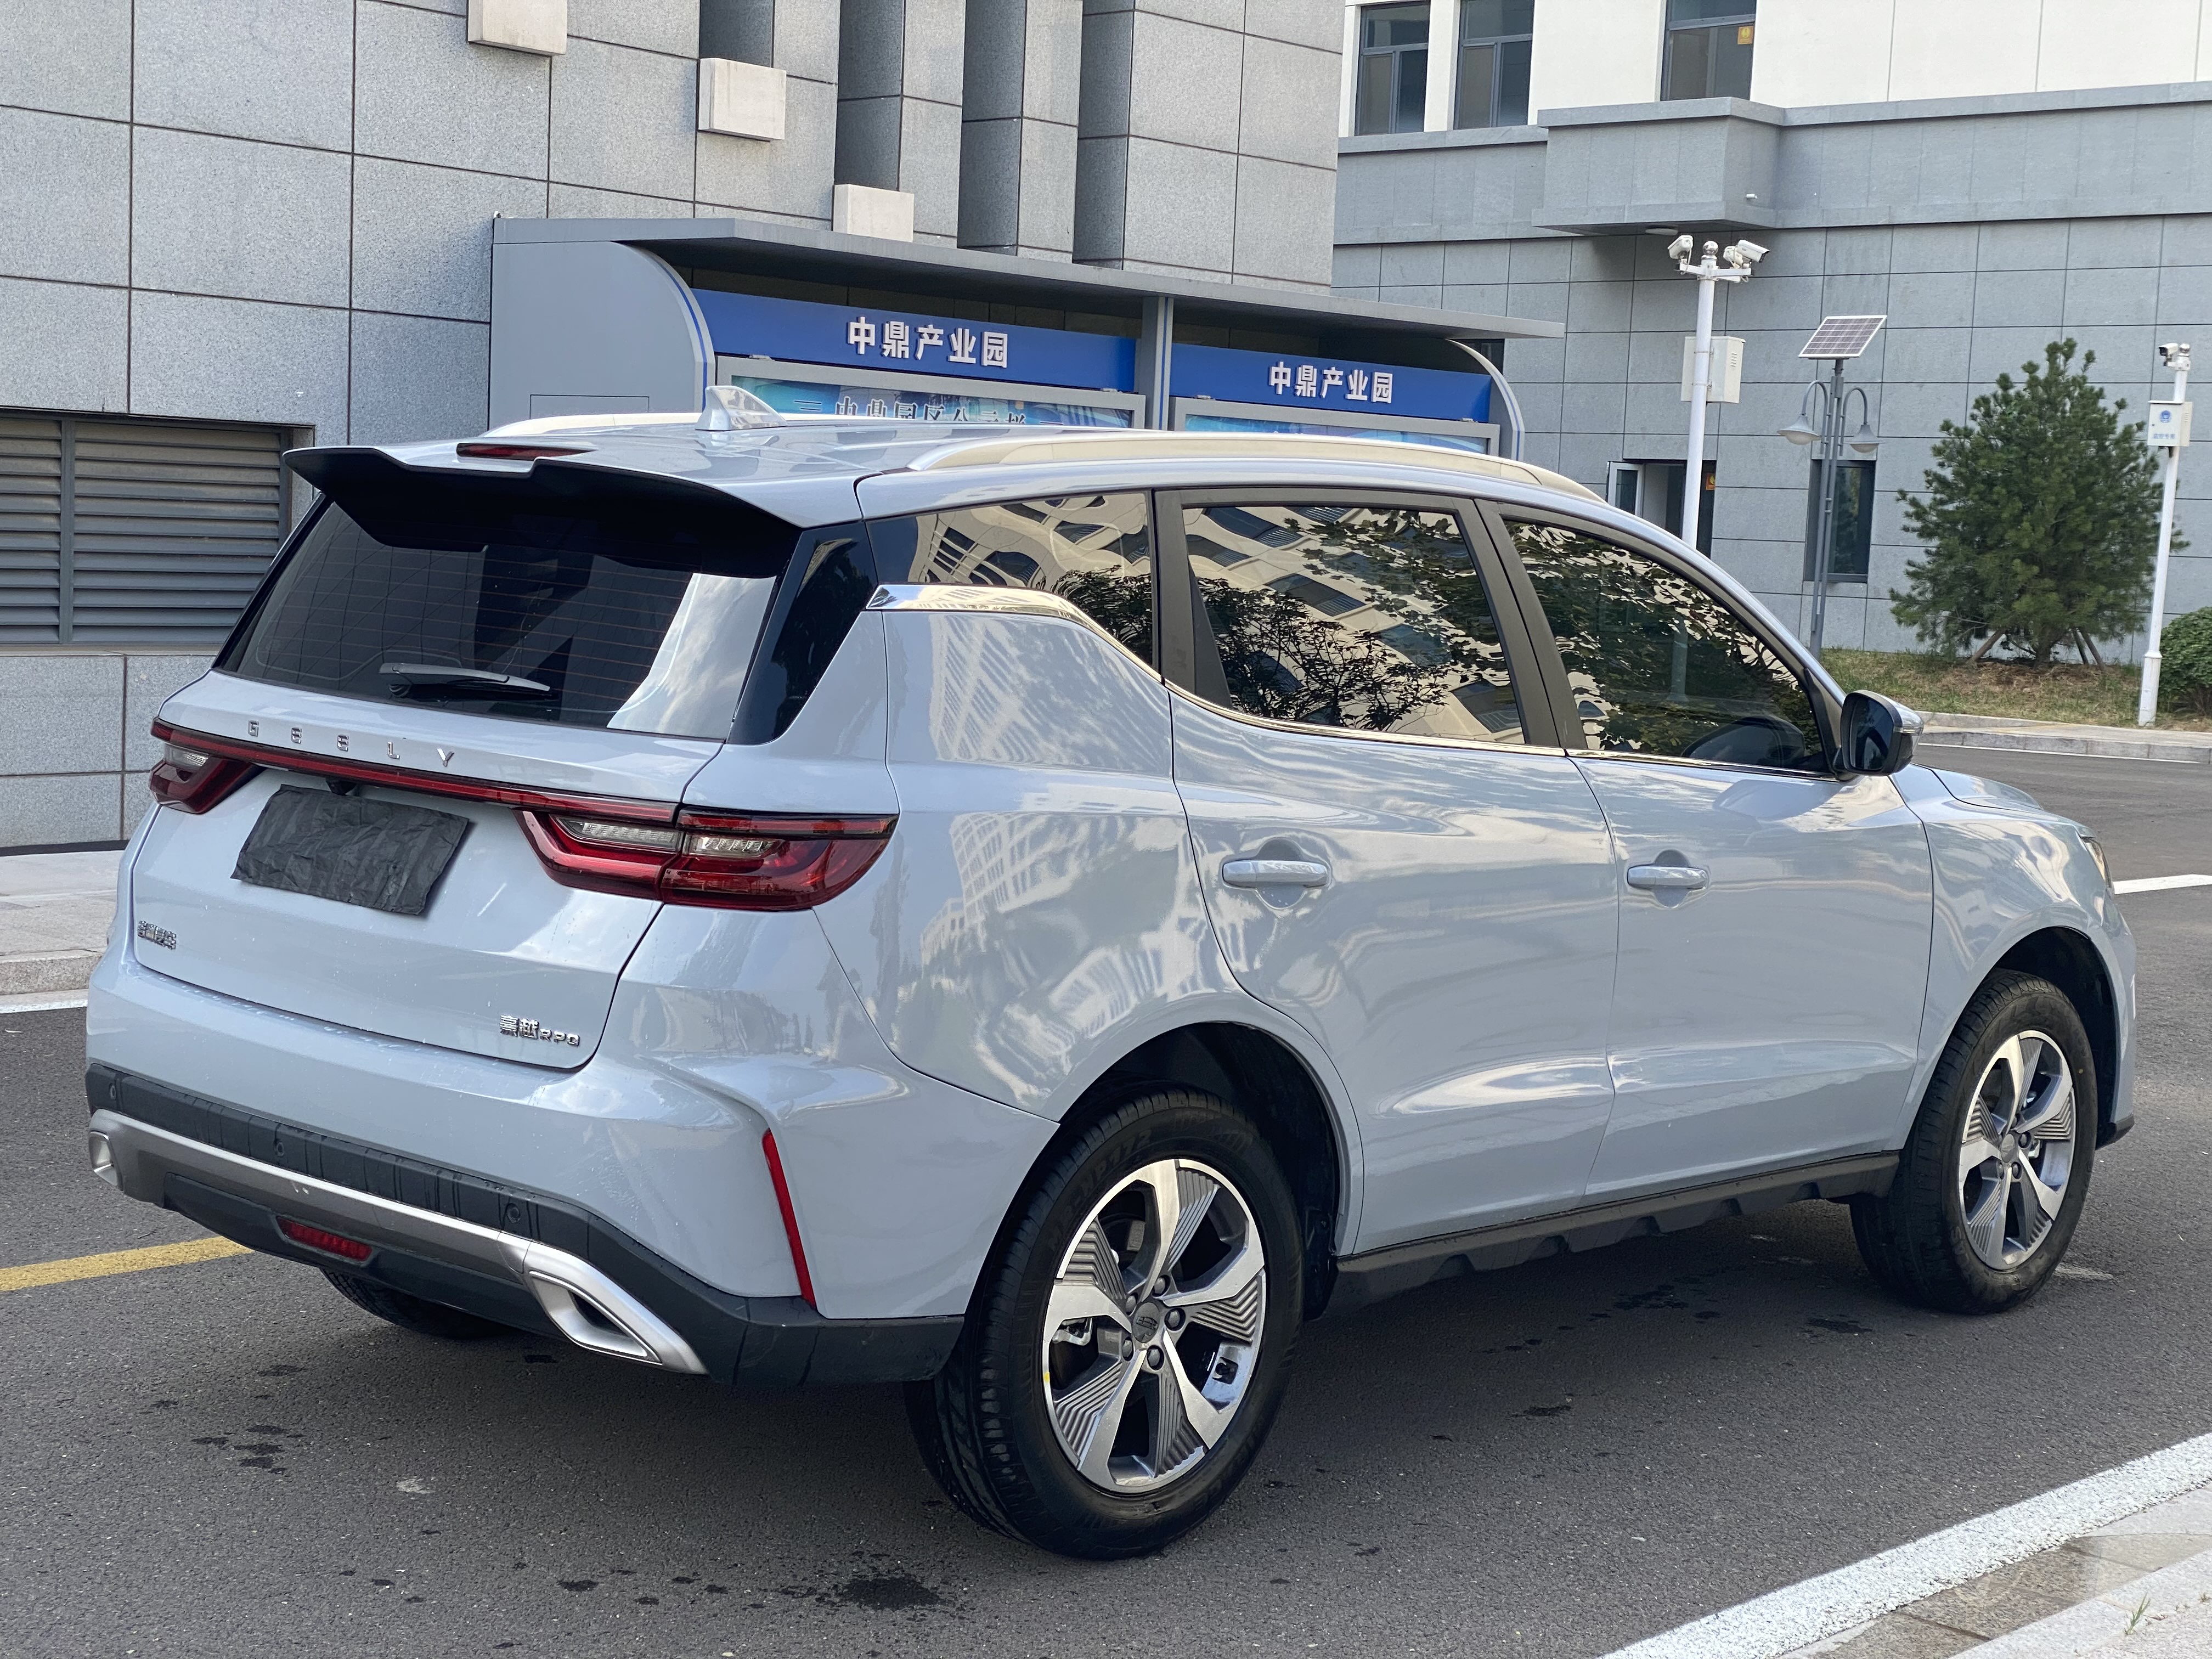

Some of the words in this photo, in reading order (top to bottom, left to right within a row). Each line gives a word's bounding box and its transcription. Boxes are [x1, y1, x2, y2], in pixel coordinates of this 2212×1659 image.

[848, 316, 1008, 368] 中鼎产业园
[1268, 361, 1393, 404] 中鼎产业园
[247, 720, 455, 768] GEELY
